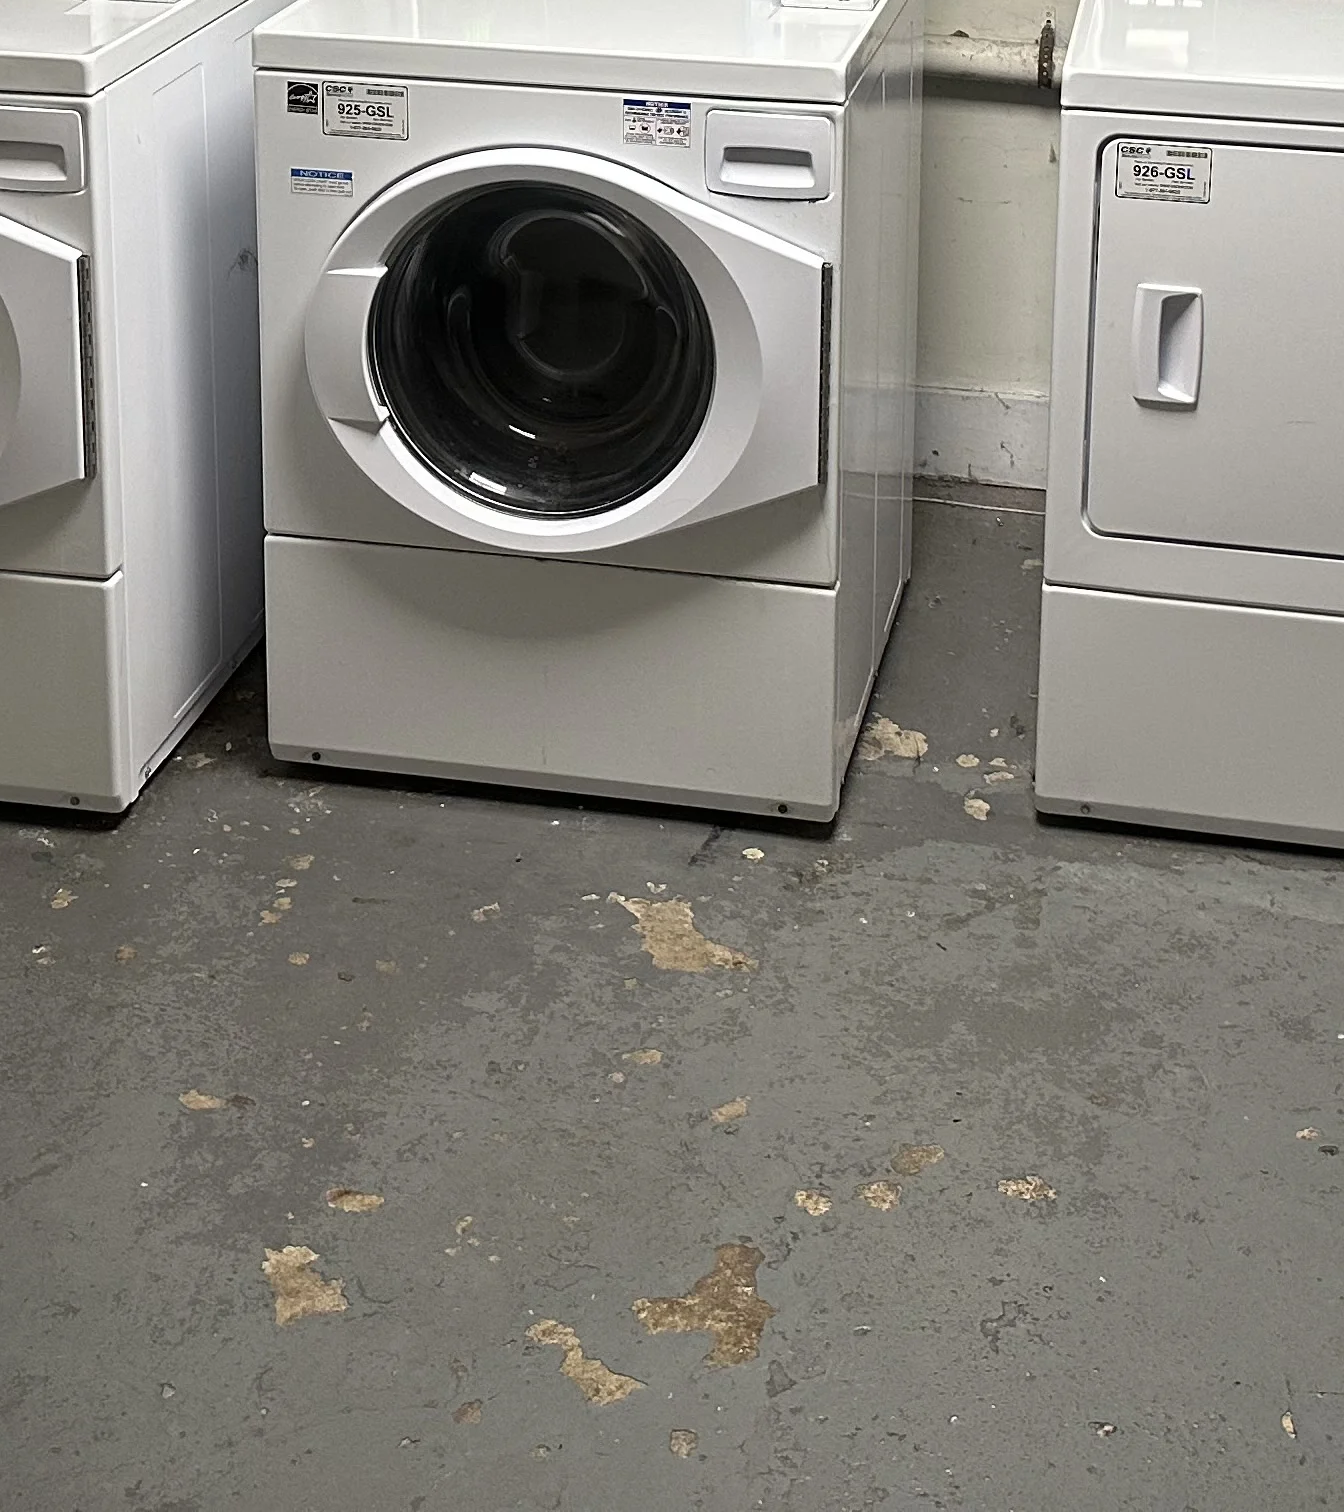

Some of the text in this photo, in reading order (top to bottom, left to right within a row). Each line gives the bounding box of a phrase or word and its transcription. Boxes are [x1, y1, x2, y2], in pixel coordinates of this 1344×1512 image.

[337, 103, 394, 118] 925-GSL
[300, 170, 344, 179] NOTICE
[1133, 165, 1195, 180] 926-GSL
